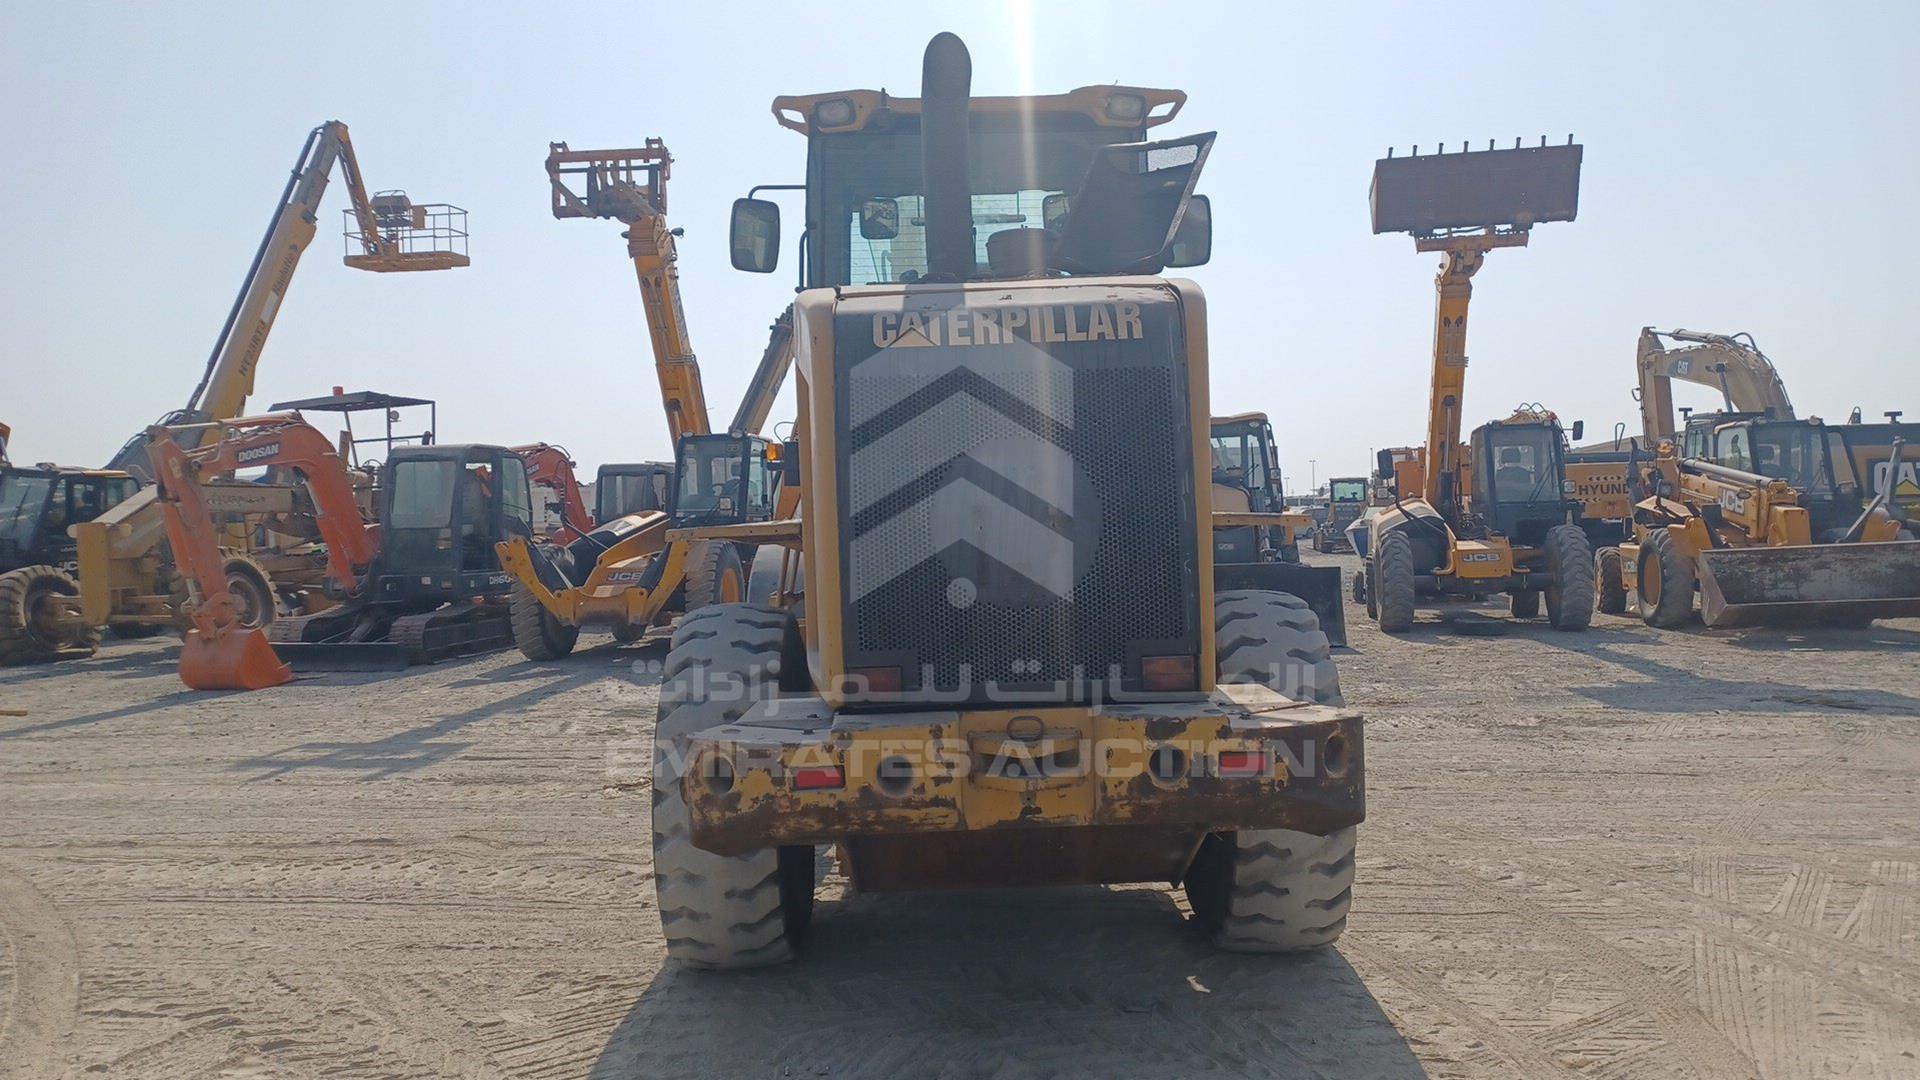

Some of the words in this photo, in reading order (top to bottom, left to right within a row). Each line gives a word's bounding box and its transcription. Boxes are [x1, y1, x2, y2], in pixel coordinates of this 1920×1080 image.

[872, 303, 1143, 348] CATERPILLAR
[1677, 360, 1689, 375] CAT
[238, 443, 279, 462] DOOSAN
[1873, 461, 1920, 496] CA
[1718, 489, 1745, 514] JCB
[1463, 552, 1500, 562] JCB
